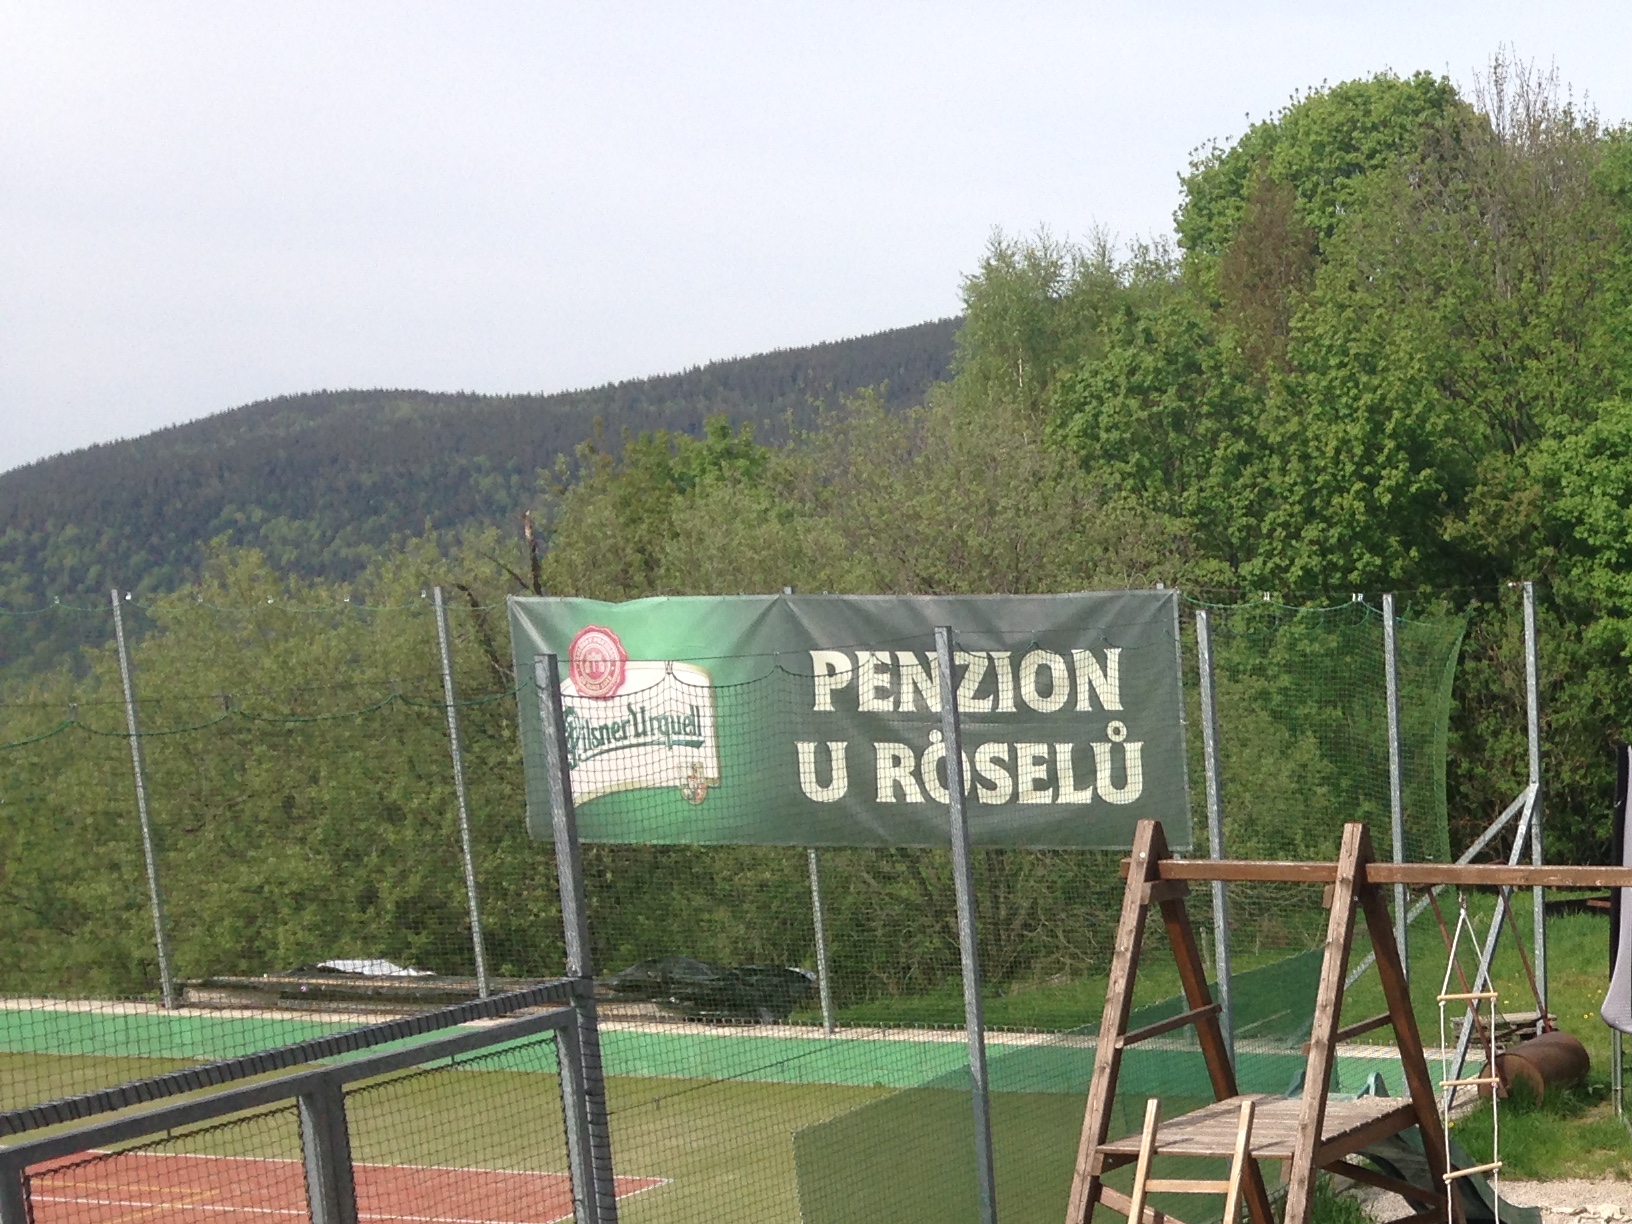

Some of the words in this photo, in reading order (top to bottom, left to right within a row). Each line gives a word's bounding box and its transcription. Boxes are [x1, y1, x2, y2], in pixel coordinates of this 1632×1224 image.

[809, 647, 1124, 713] PENZION
[563, 705, 630, 770] Pilsner
[627, 702, 703, 750] Urquell
[794, 741, 848, 802] U
